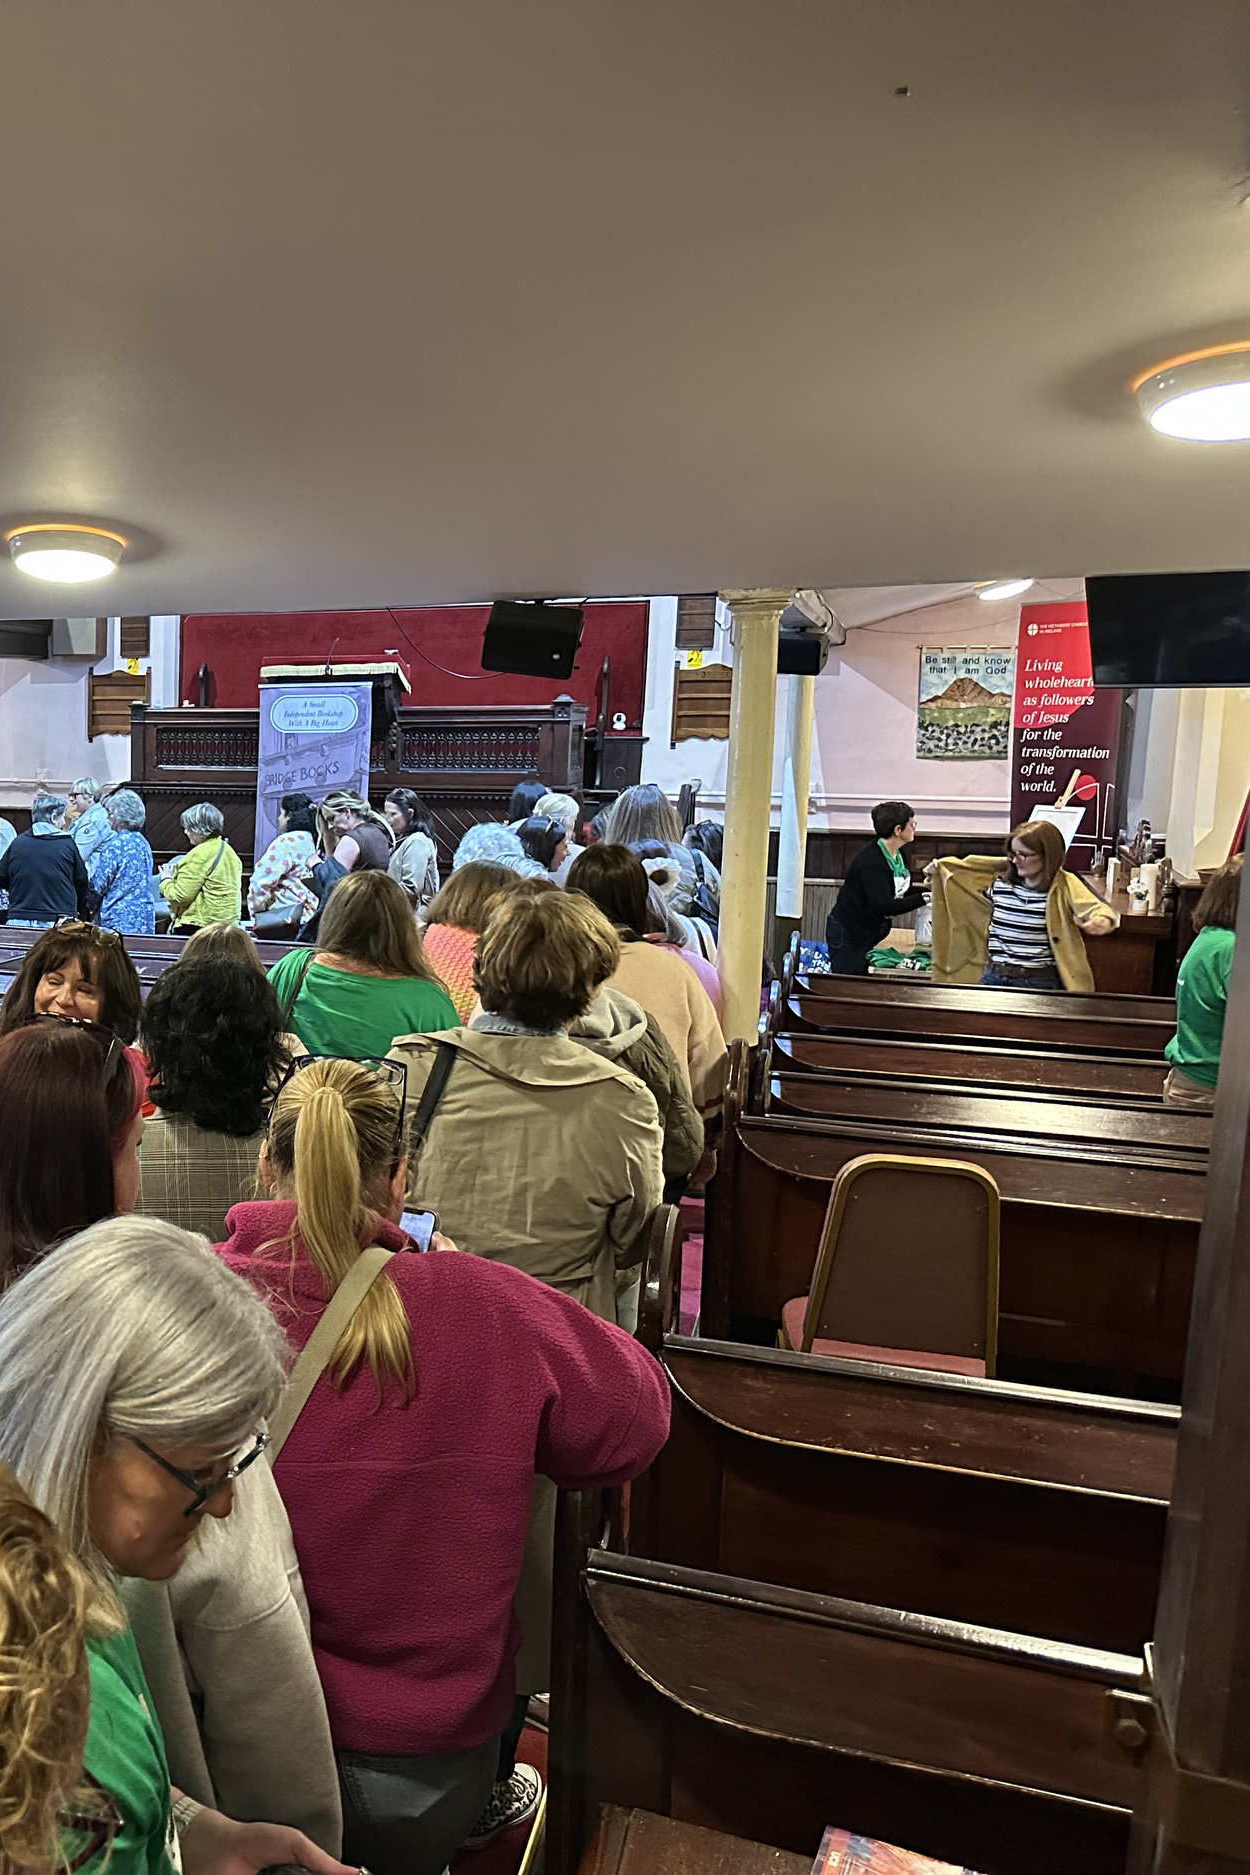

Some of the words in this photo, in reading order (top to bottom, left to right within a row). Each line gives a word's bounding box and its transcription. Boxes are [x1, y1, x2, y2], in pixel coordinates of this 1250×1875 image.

[925, 656, 938, 664] Be
[942, 656, 957, 664] still
[984, 656, 1011, 664] know
[1024, 659, 1063, 673] Living
[929, 666, 947, 674] that
[985, 666, 1007, 674] God
[1023, 696, 1037, 705] as
[1038, 694, 1094, 708] followers
[283, 710, 316, 719] Independent
[317, 710, 344, 719] Bookshop
[1022, 711, 1038, 724] of
[1037, 711, 1069, 724] Jesus
[288, 719, 303, 727] With
[322, 719, 339, 727] Heart
[1020, 729, 1041, 742] for
[1042, 728, 1063, 741] the
[1021, 746, 1110, 760] transformation
[264, 770, 297, 787] BRIDGE
[300, 761, 340, 781] BOOKS
[1020, 763, 1036, 777] of
[1035, 763, 1055, 775] the
[1020, 780, 1057, 792] world.
